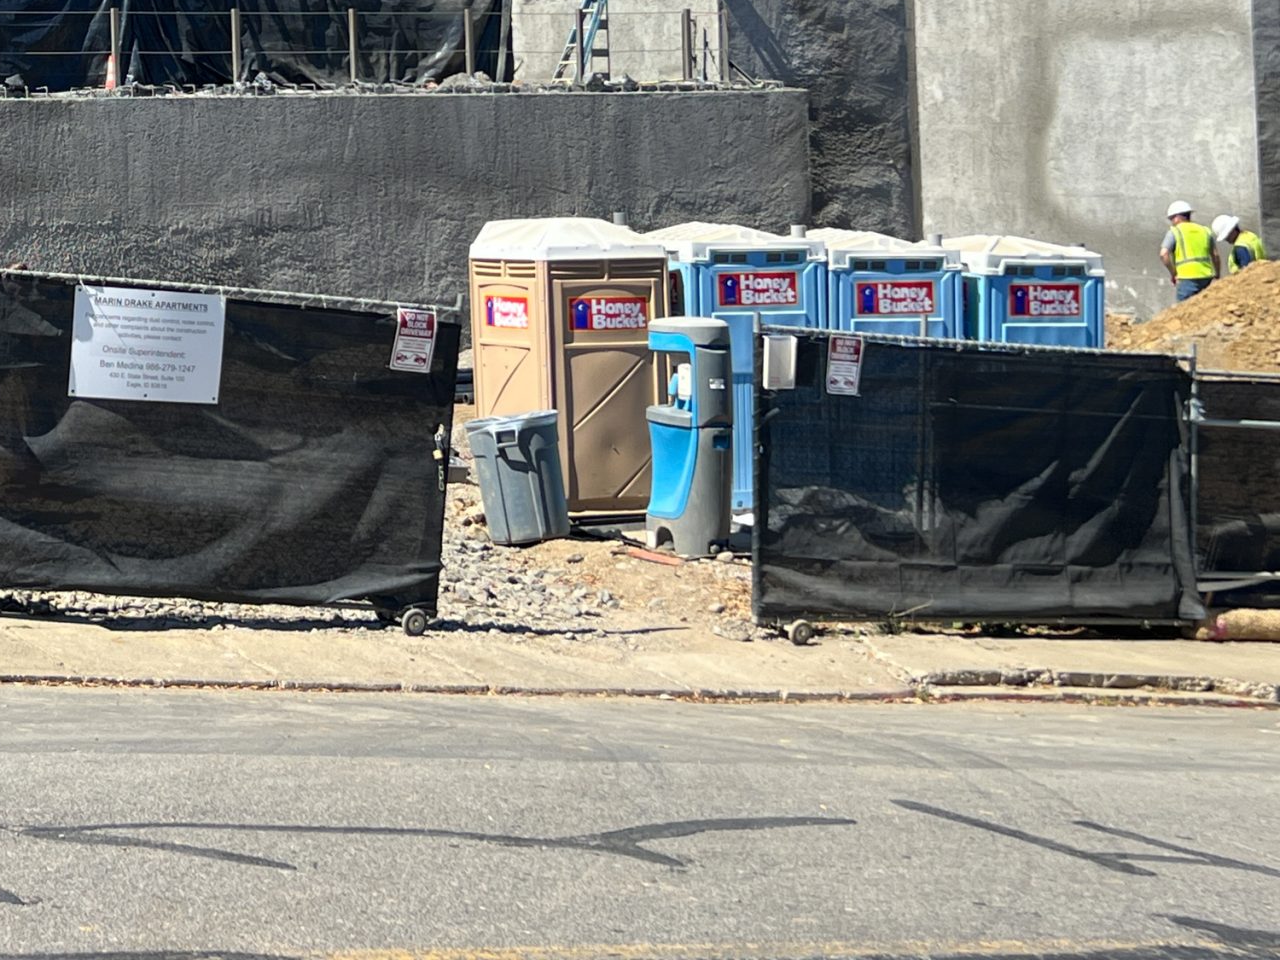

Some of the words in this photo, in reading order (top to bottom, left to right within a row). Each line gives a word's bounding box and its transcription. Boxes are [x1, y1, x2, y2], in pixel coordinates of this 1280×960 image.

[739, 274, 791, 291] Honey
[740, 288, 796, 304] Bucket
[877, 283, 929, 300] Honey
[1028, 286, 1075, 303] Honey
[94, 296, 122, 307] MARIN
[124, 298, 153, 309] DRAKE
[155, 301, 208, 313] APARTMENTS
[492, 296, 525, 314] Honey
[591, 298, 641, 316] Honey
[878, 297, 934, 314] Bucket
[1029, 300, 1079, 315] Bucket
[406, 312, 416, 321] DO
[407, 320, 427, 329] BLOCK
[494, 311, 528, 328] Bucket
[592, 314, 646, 329] Bucket
[400, 328, 432, 337] DRIVEWAY
[102, 344, 127, 354] Onsite
[99, 359, 114, 368] Ben
[116, 361, 144, 370] Medina
